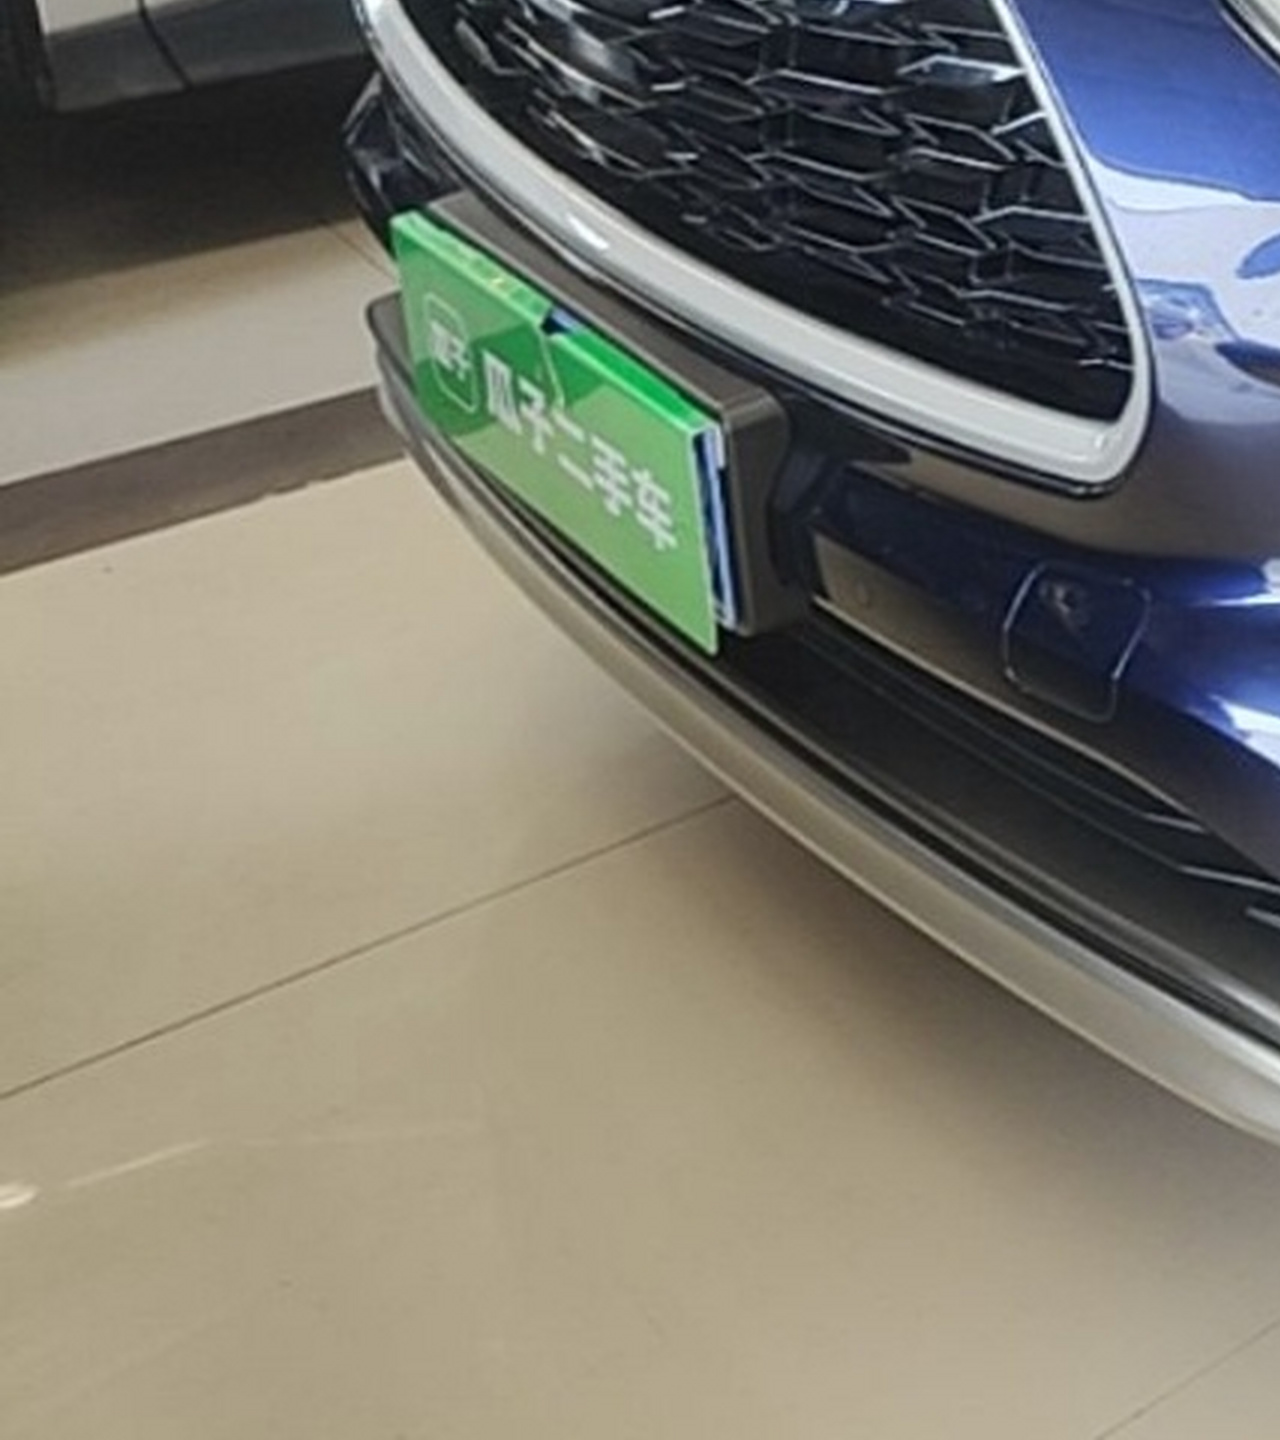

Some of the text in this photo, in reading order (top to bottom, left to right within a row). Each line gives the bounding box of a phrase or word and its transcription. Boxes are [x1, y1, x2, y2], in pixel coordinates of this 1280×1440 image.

[482, 348, 678, 551] 瓜子二手车
